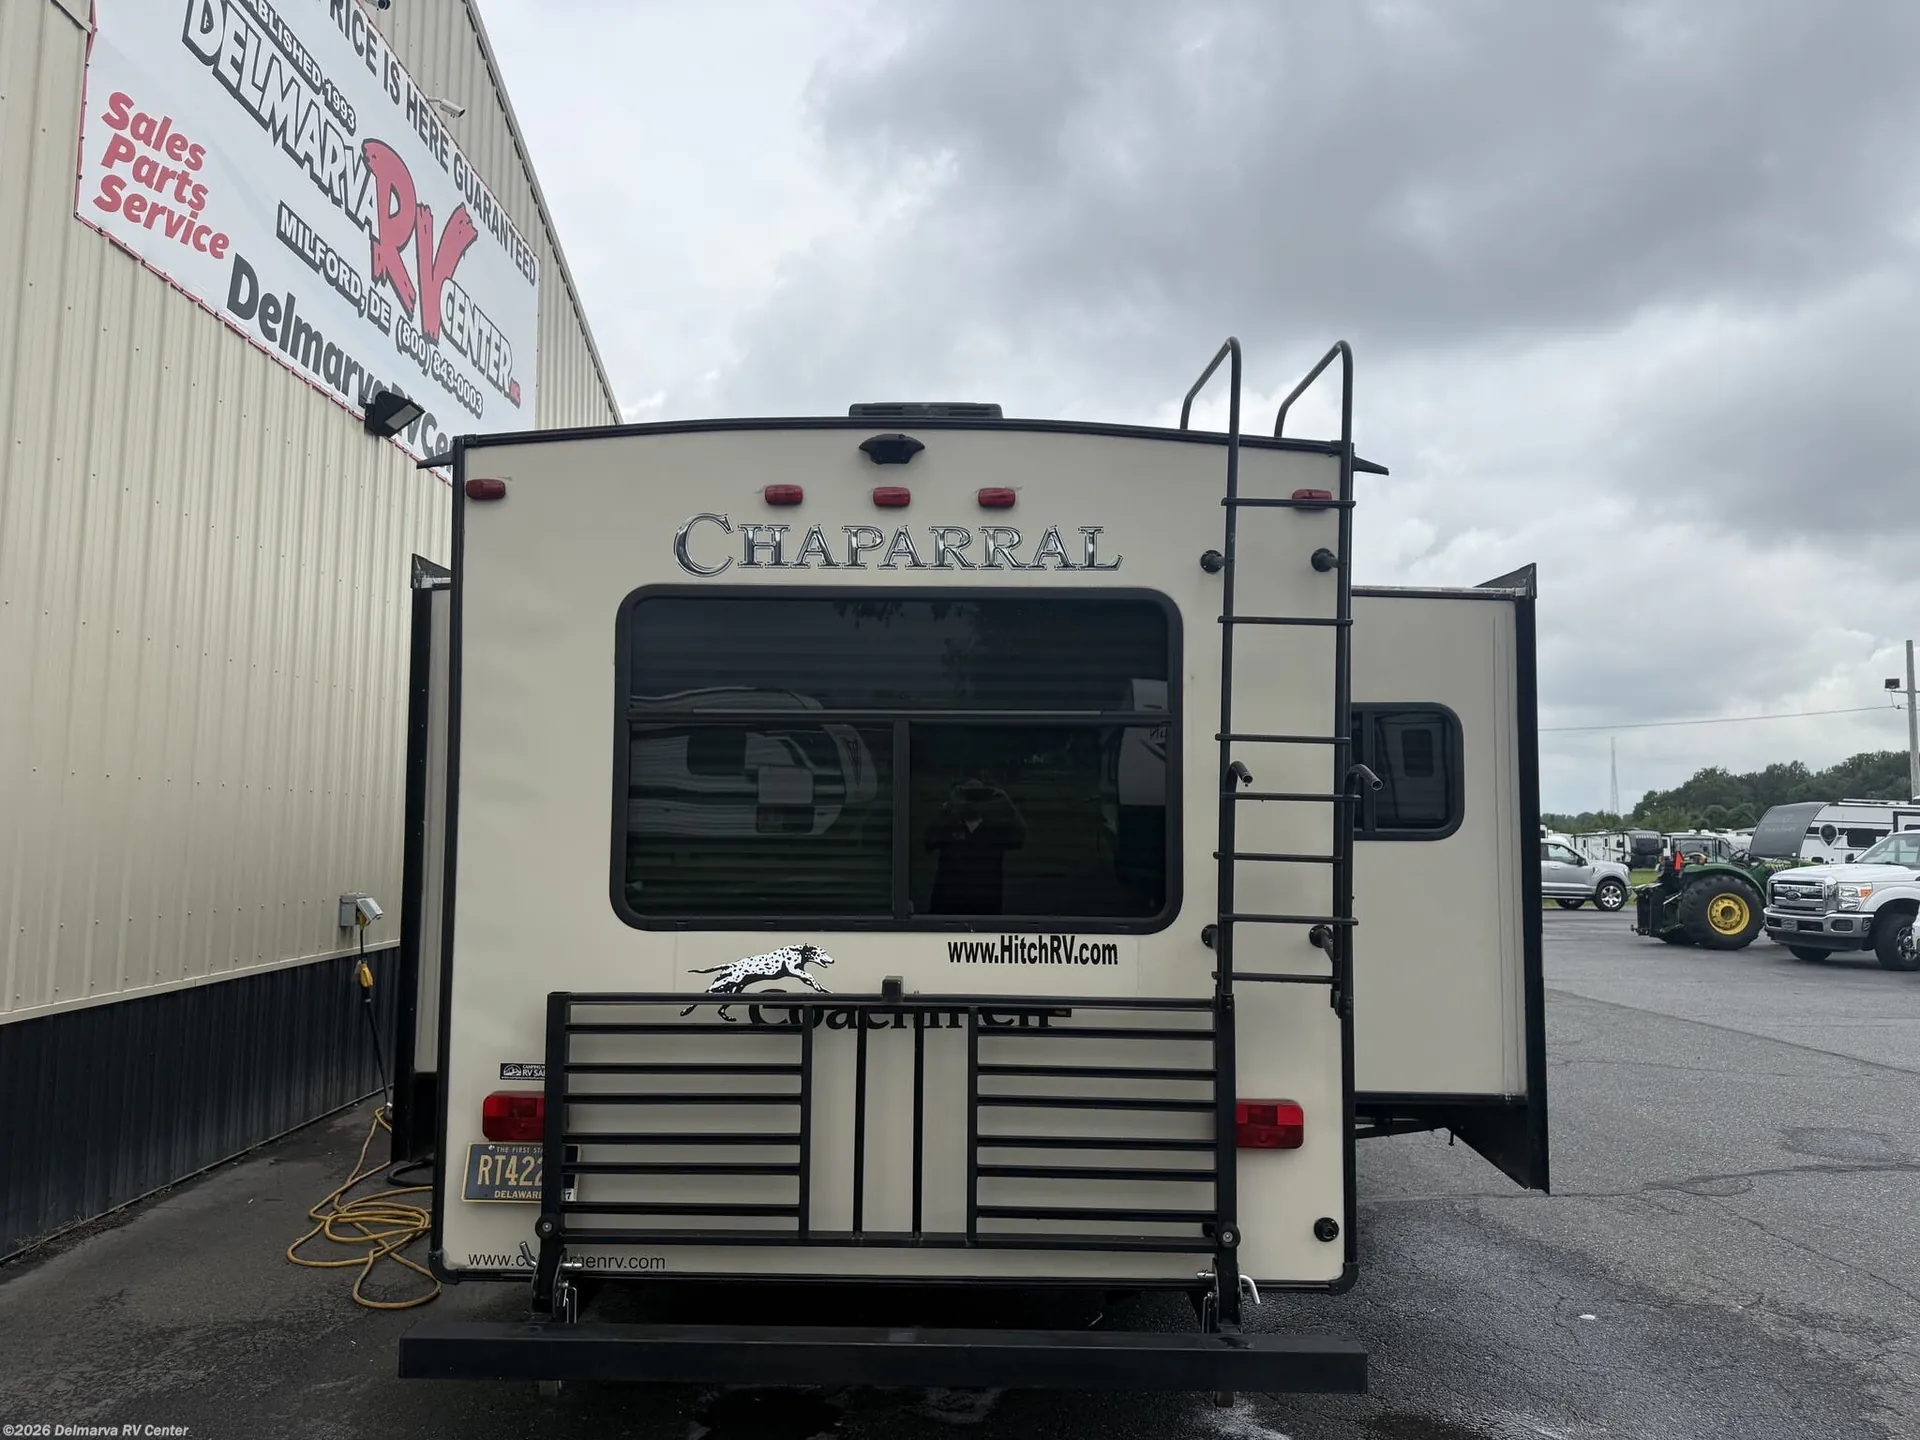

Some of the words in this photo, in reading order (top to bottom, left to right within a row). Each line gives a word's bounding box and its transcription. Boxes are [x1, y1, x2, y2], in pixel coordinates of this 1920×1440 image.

[101, 92, 207, 171] Sales
[323, 80, 357, 136] 1993
[101, 133, 210, 211] Parts
[182, 0, 381, 246] DELMARVA
[362, 138, 479, 346] RV
[440, 278, 513, 398] CENTER
[383, 48, 401, 105] IS
[406, 80, 449, 176] HERE
[454, 152, 537, 288] GUARANTEED
[93, 174, 230, 259] Service
[276, 200, 367, 318] MILFORD,
[367, 285, 391, 337] DE
[396, 314, 432, 378] (800)
[431, 347, 485, 420] 843-0003
[673, 513, 1125, 577] CHAPARRAL
[947, 935, 1119, 966] www.HitchRV.com
[512, 1146, 531, 1154] FIRST
